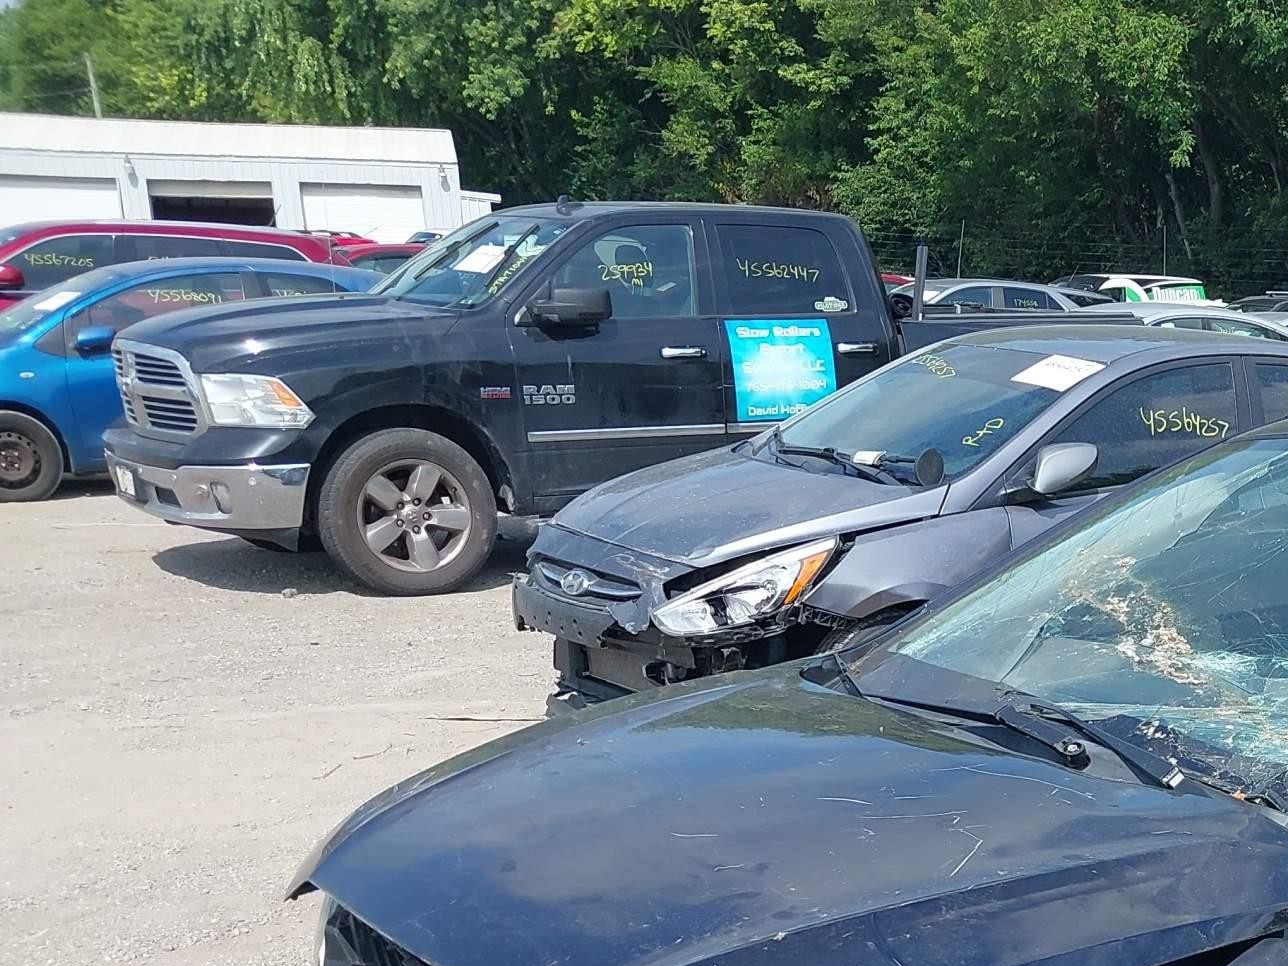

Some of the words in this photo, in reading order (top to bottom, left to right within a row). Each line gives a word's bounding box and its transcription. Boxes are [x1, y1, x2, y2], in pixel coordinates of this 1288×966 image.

[25, 253, 95, 267] 45567205
[597, 261, 653, 281] 259934
[735, 257, 821, 283] 45562447
[736, 326, 770, 338] Slow
[522, 384, 576, 395] RAM
[523, 394, 576, 405] 1500
[748, 405, 779, 416] David
[1139, 406, 1231, 439] 45564257
